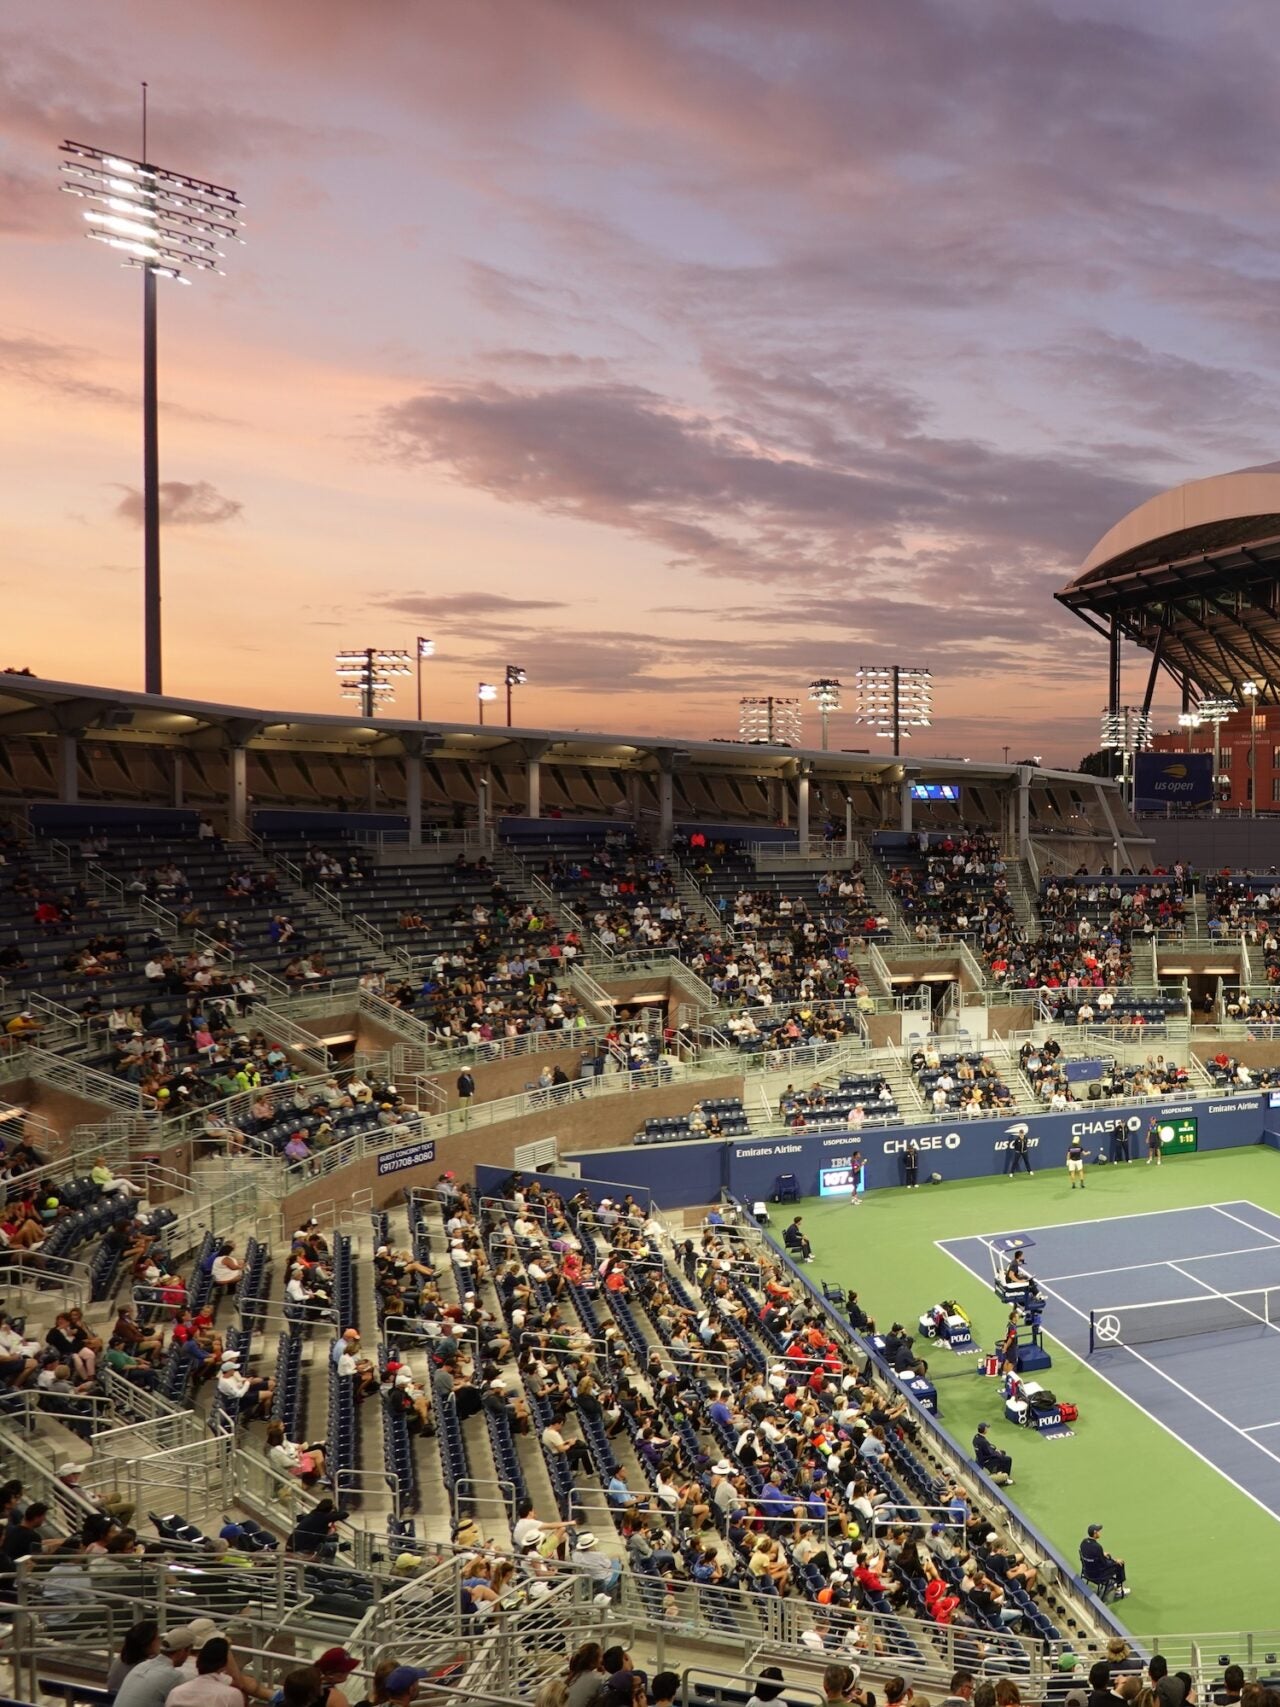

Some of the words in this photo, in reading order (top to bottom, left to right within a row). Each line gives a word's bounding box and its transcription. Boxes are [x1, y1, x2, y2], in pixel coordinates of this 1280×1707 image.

[1154, 781, 1167, 791] us
[1167, 781, 1194, 792] open
[1161, 1106, 1193, 1115] USOPEN.ORG
[1208, 1104, 1237, 1113] Emirates
[823, 1137, 861, 1146] USOPEN.ORG
[884, 1136, 942, 1154] CHASE
[995, 1140, 1009, 1151] us
[737, 1148, 772, 1158] Emirates
[831, 1157, 852, 1168] IBM
[950, 1333, 971, 1344] POLO
[1039, 1414, 1061, 1427] POLO
